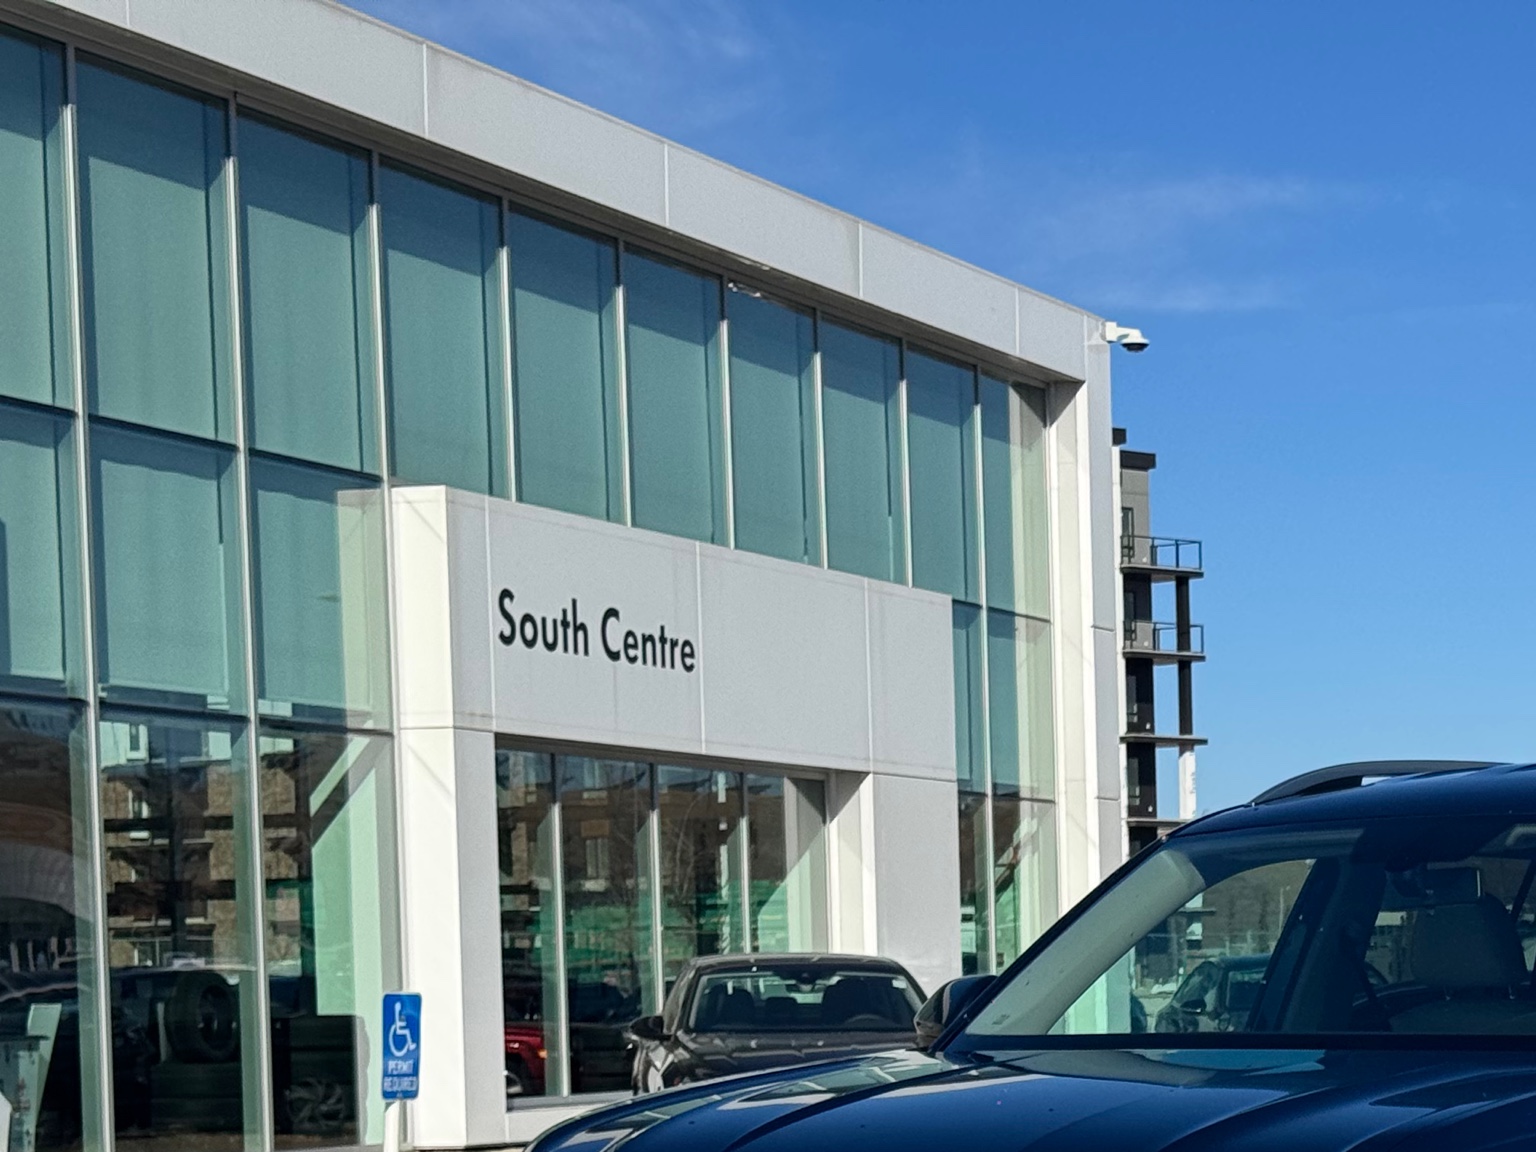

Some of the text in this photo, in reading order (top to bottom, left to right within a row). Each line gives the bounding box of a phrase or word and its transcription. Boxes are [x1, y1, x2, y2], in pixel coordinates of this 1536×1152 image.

[498, 588, 696, 673] South Centre
[387, 1060, 414, 1075] PERMIT
